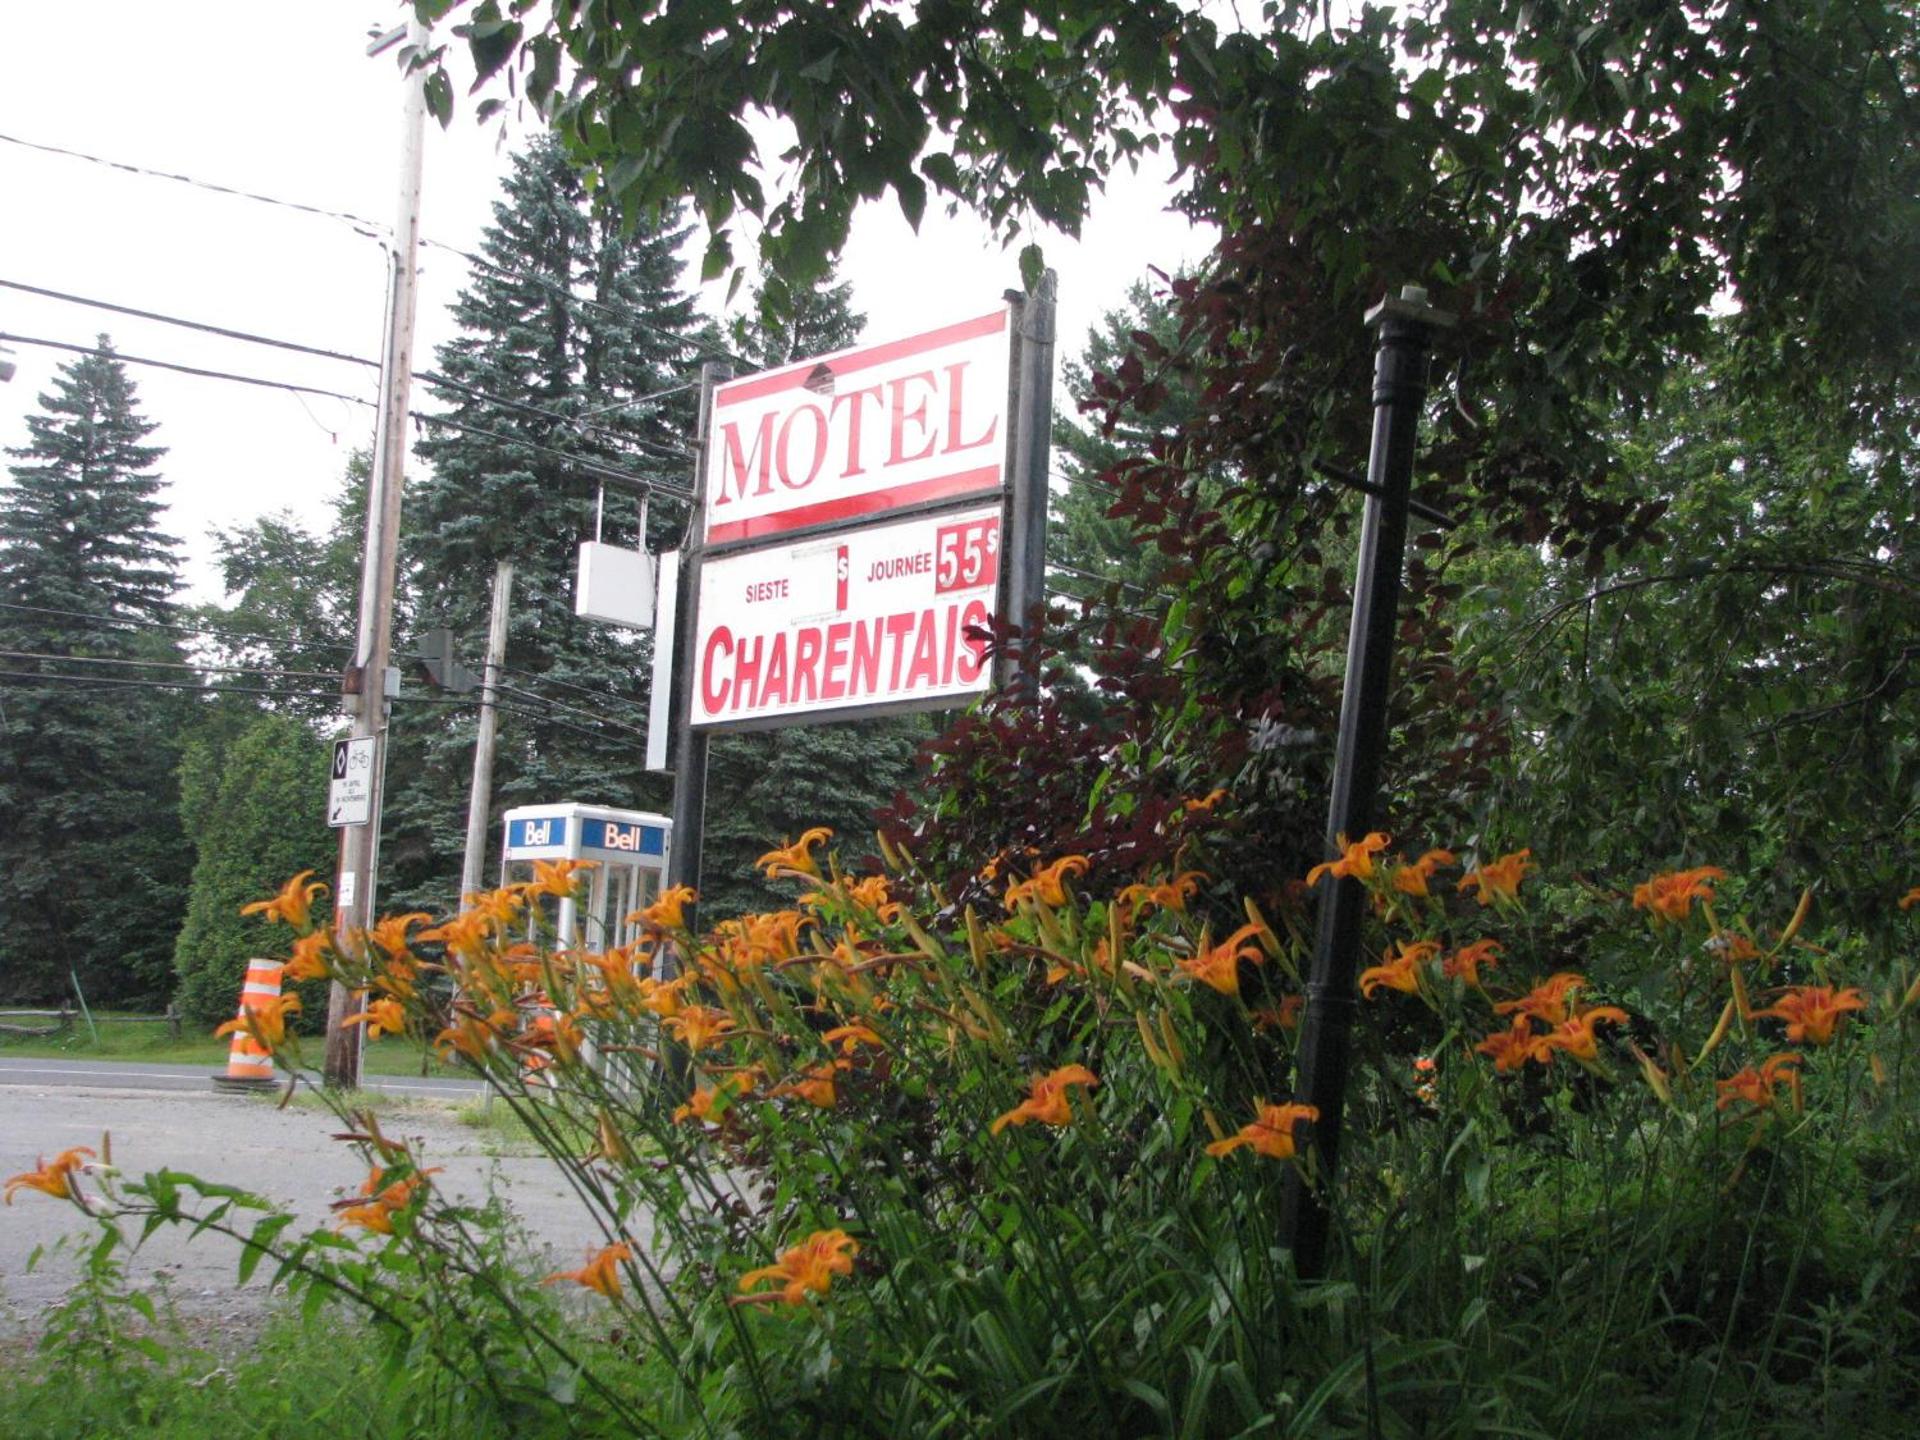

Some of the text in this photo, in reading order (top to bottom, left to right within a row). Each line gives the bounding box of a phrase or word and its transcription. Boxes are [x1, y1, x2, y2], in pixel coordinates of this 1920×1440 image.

[714, 361, 998, 507] MOTEL
[867, 550, 931, 583] JOURNÉE
[745, 578, 789, 603] SIESTE
[702, 599, 987, 715] CHARENTAIS
[525, 821, 551, 846] Bell
[604, 823, 641, 852] Bell
